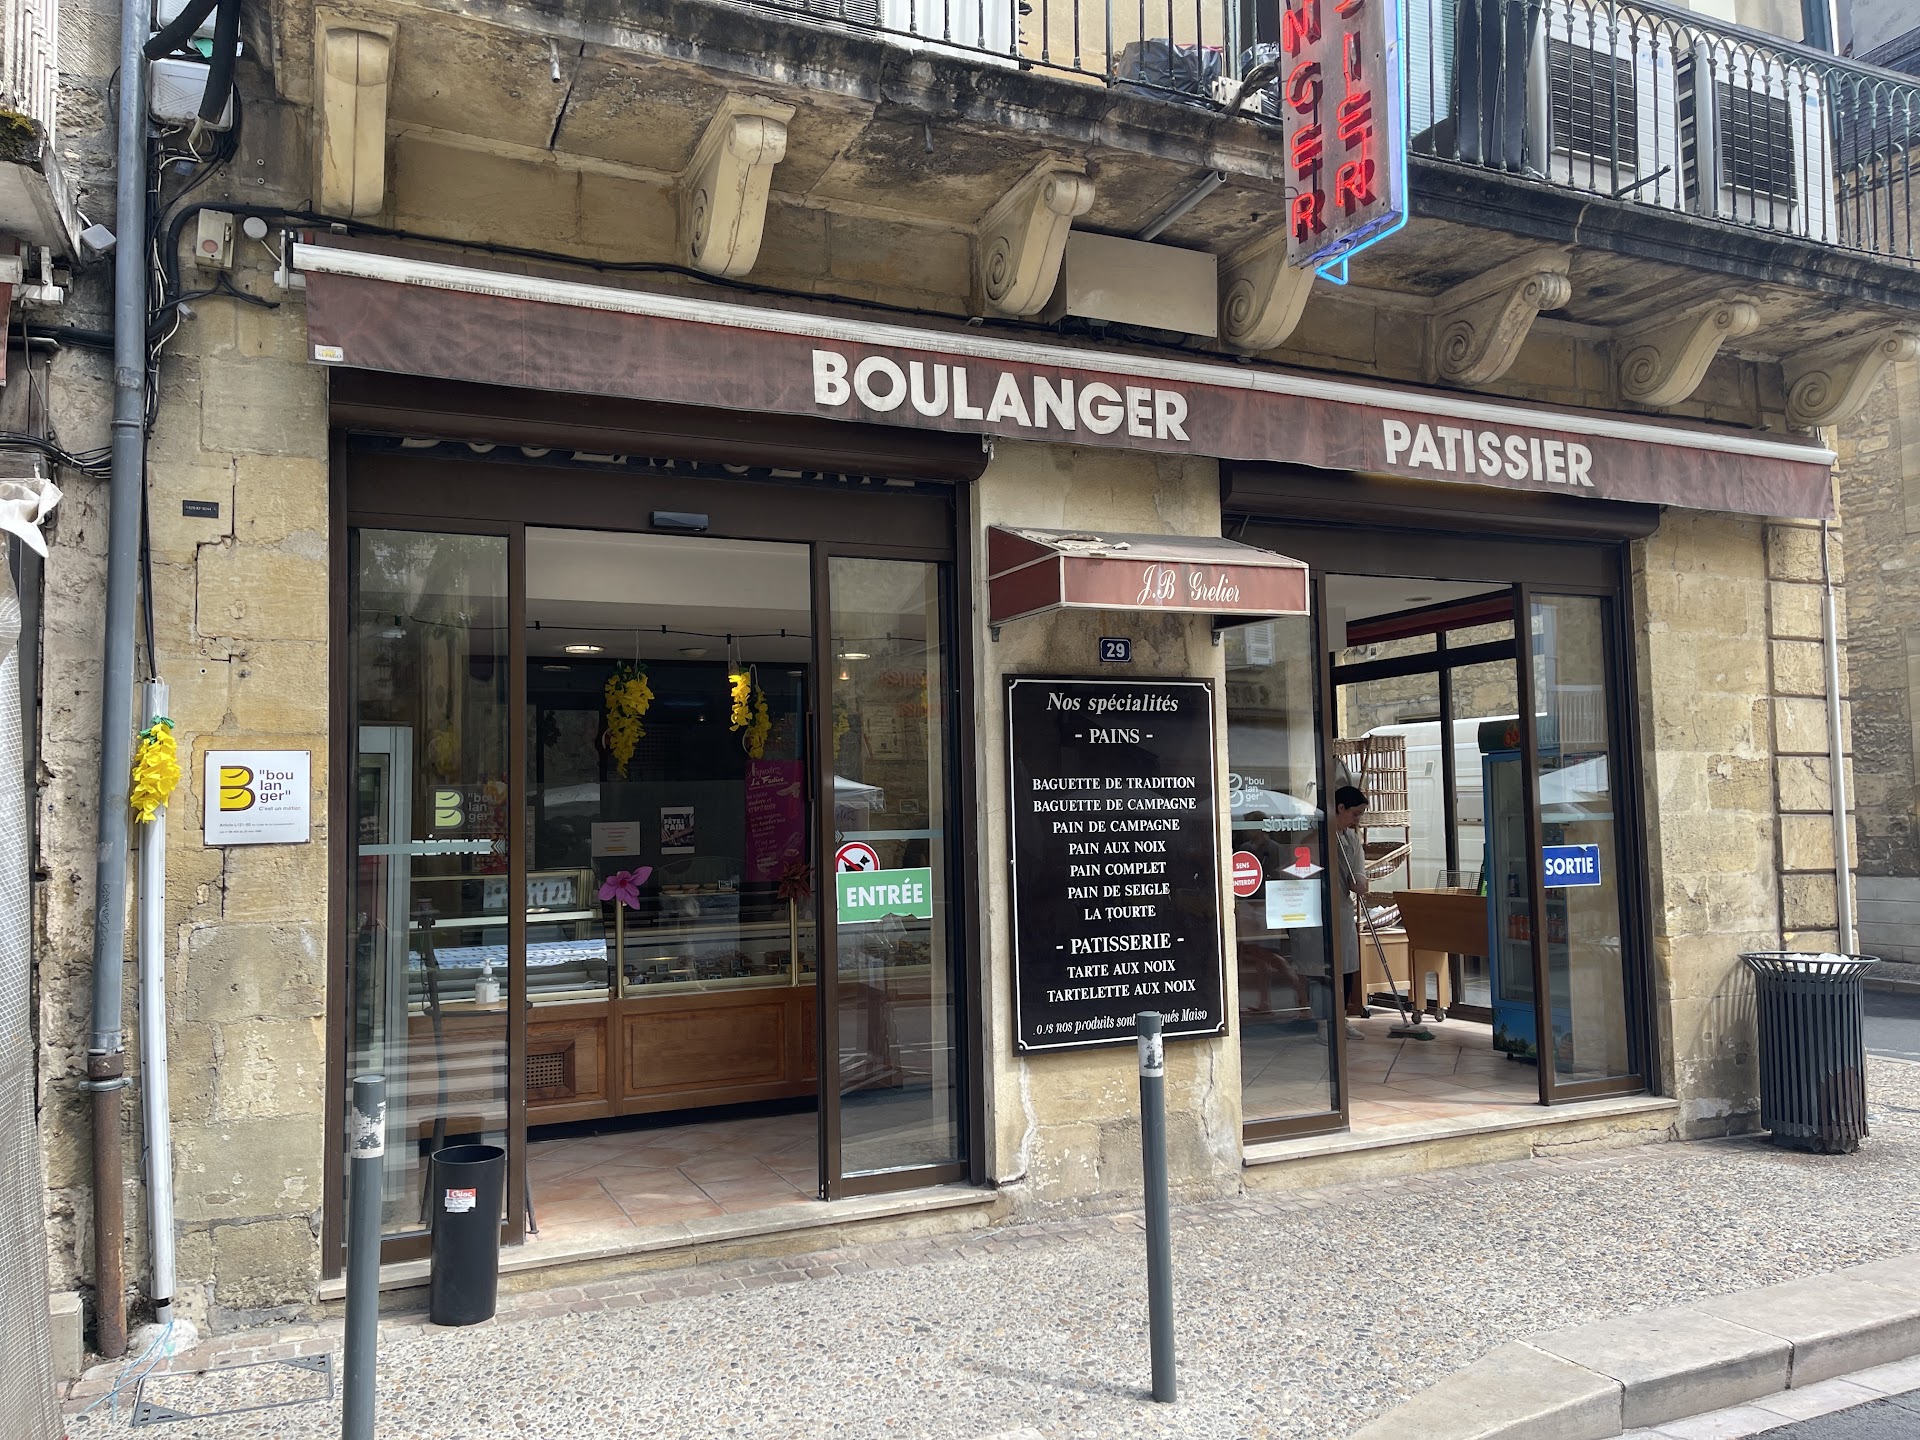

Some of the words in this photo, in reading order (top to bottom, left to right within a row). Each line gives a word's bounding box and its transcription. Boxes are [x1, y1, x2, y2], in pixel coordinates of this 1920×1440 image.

[1334, 0, 1377, 218] IER
[812, 349, 1190, 441] BOULANGER
[1382, 418, 1595, 487] PATISSIER
[1136, 564, 1177, 606] J.B
[1188, 570, 1241, 603] Grelier
[1106, 641, 1126, 659] 29
[1046, 692, 1082, 712] Nos
[1087, 693, 1179, 715] spécialités
[1088, 728, 1141, 744] PAINS
[260, 780, 282, 791] lan
[1032, 778, 1101, 791] BAGUETTE
[1105, 777, 1123, 790] DE
[1126, 776, 1196, 789] TRADITION
[1245, 784, 1259, 793] lan
[468, 801, 488, 812] lan
[1033, 799, 1102, 812] BAGUETTE
[1106, 798, 1124, 811] DE
[1127, 797, 1197, 811] CAMPAGNE
[1052, 820, 1084, 834] PAIN
[1088, 820, 1106, 833] DE
[1110, 818, 1181, 832] CAMPAGNE
[1068, 842, 1100, 855] PAIN
[1103, 841, 1131, 854] AUX
[1134, 840, 1167, 853] NOIX
[1070, 864, 1101, 877] PAIN
[1104, 862, 1167, 876] COMPLET
[1545, 856, 1594, 875] SORTIE
[846, 877, 924, 908] ENTRÉE
[1067, 886, 1099, 899] PAIN
[1103, 885, 1121, 898] DE
[1124, 883, 1170, 896] SEIGLE
[1084, 907, 1102, 920] LA
[1105, 905, 1157, 920] TOURTE
[1070, 932, 1172, 954] PATISSERIE
[1067, 963, 1109, 979] TARTE
[1113, 962, 1140, 975] AUX
[1143, 959, 1176, 974] NOIX
[1047, 984, 1130, 1003] TARTELETTE
[1134, 982, 1160, 996] AUX
[1164, 979, 1197, 993] NOIX
[1056, 1020, 1073, 1034] nos
[1074, 1014, 1115, 1035] produits
[1116, 1012, 1137, 1029] sont
